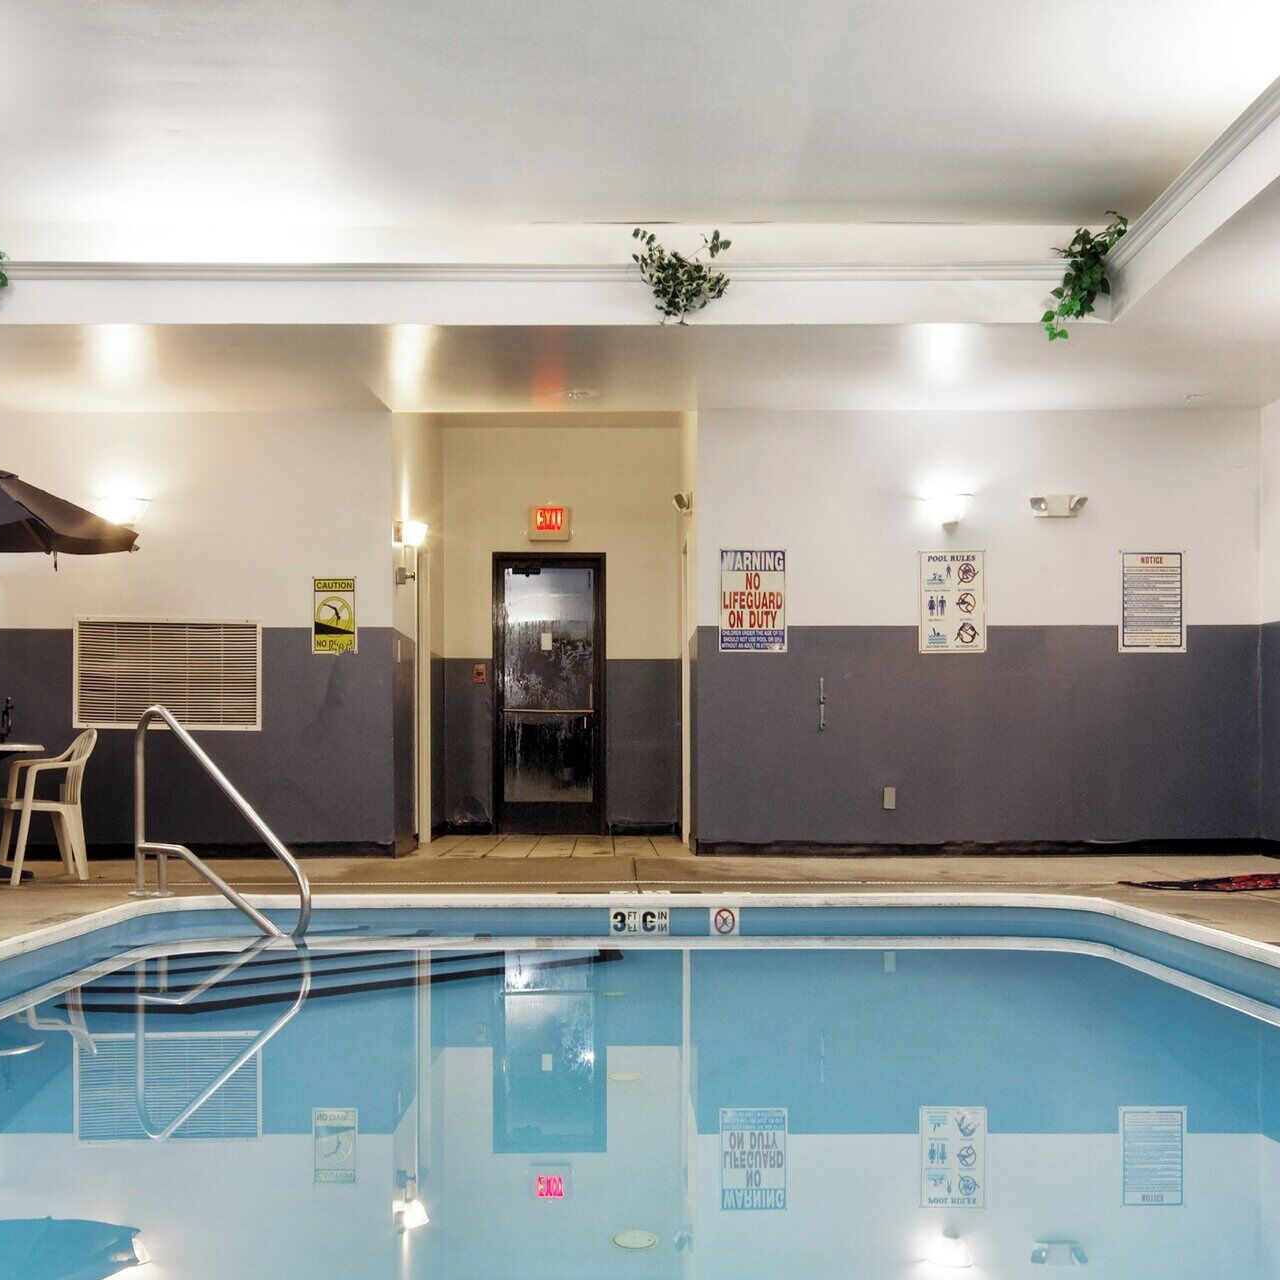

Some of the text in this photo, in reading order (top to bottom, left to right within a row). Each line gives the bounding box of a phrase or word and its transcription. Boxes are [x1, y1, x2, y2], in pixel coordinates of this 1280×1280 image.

[536, 508, 564, 530] EXIT
[722, 551, 784, 571] WARNING
[1141, 556, 1164, 564] NOTICE
[746, 572, 761, 590] NO
[723, 592, 783, 609] LIFEGUARD
[728, 610, 777, 628] ON DUTY
[628, 911, 637, 920] FT
[658, 911, 667, 920] IN
